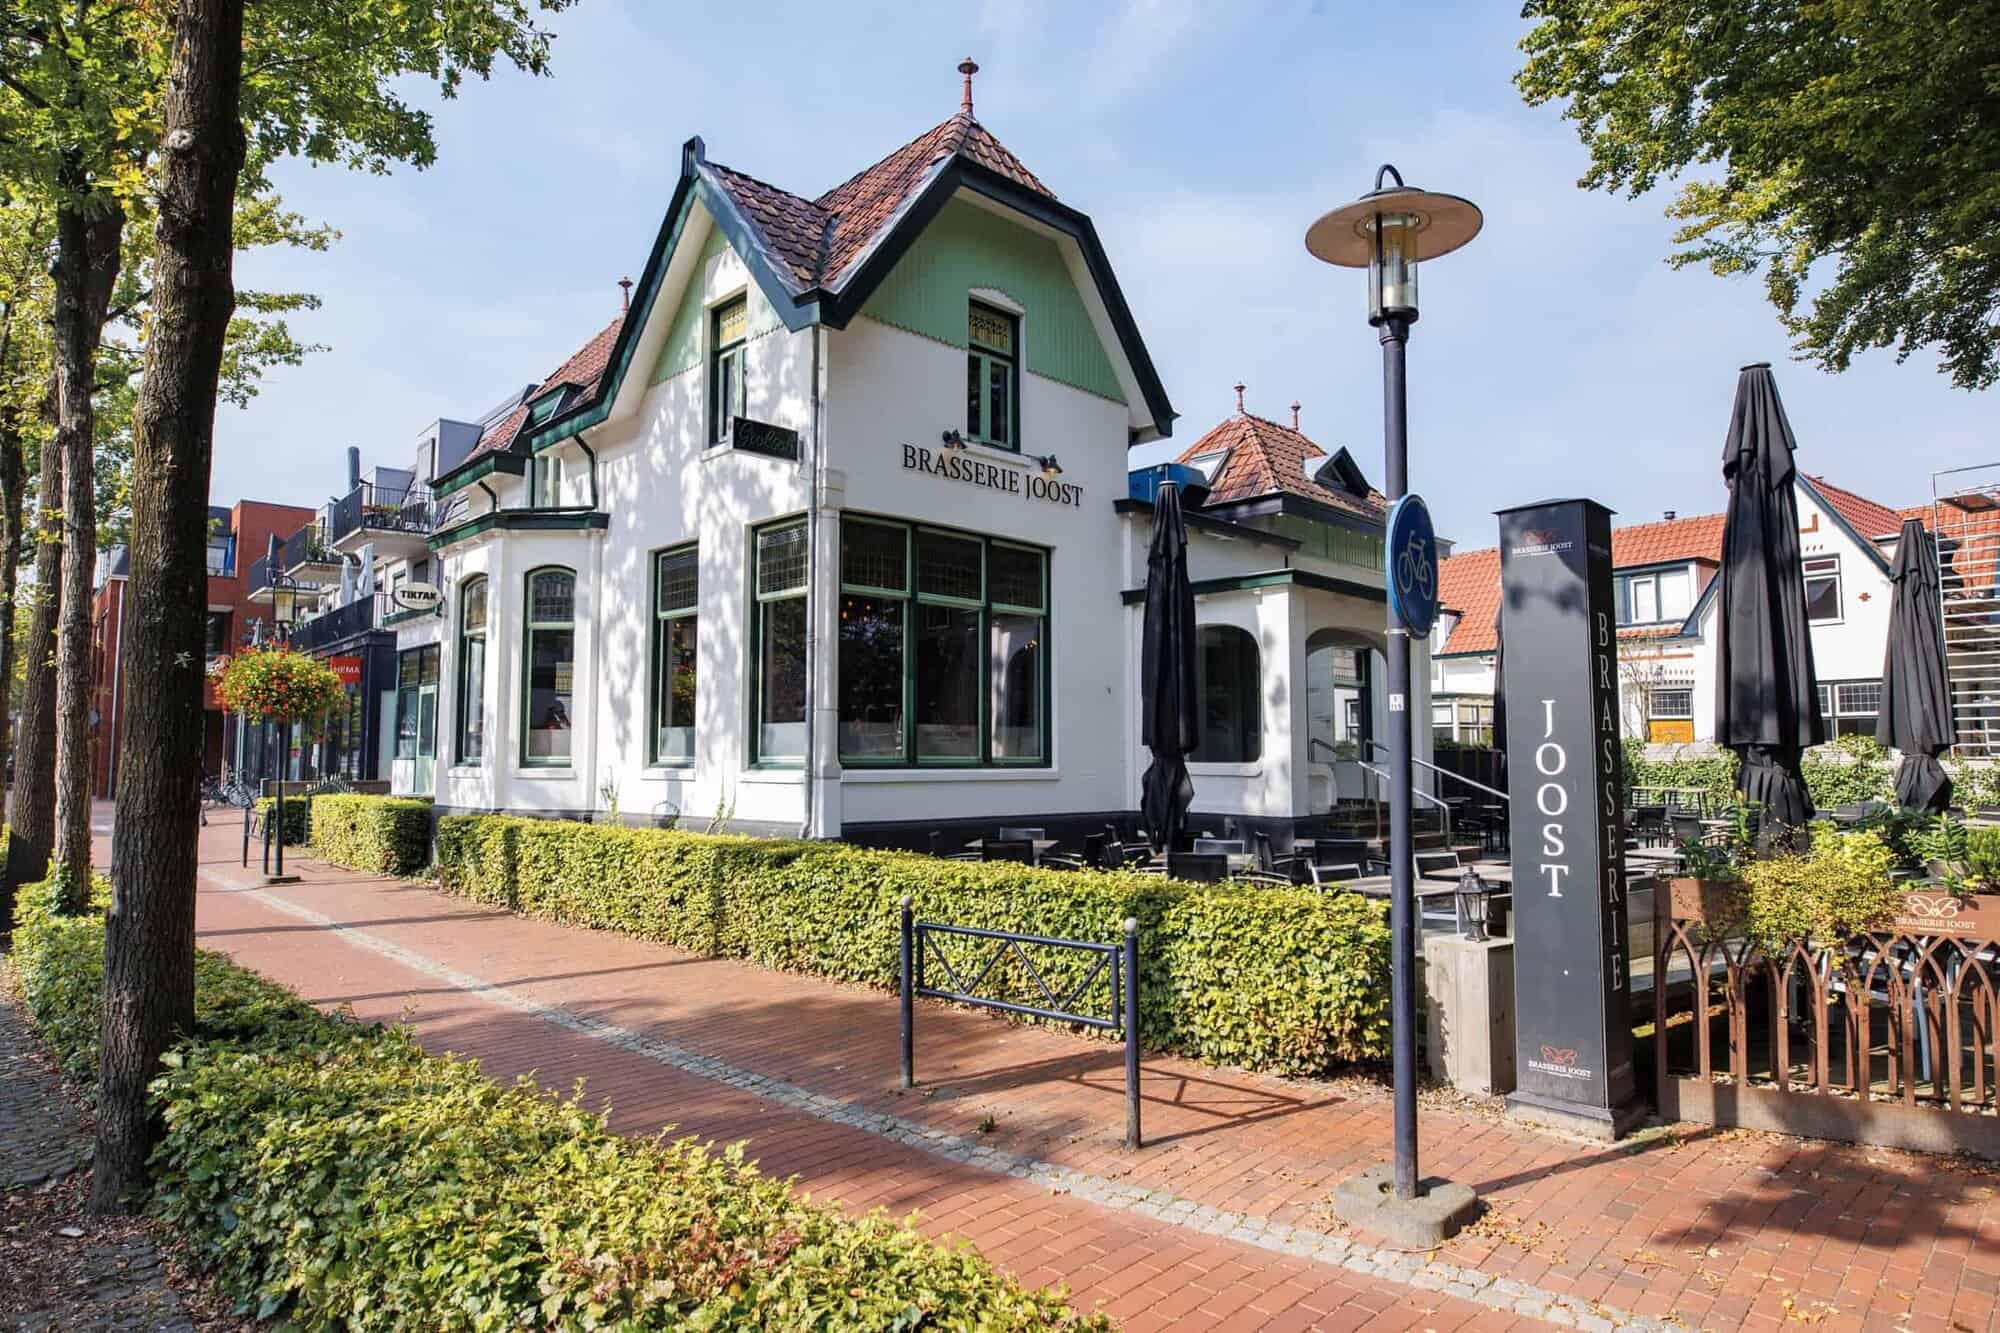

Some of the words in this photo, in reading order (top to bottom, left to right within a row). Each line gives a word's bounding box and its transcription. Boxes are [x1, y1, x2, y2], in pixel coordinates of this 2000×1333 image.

[903, 444, 1019, 493] BRASSERIE
[1026, 474, 1083, 507] JOOST
[1535, 699, 1569, 897] JOOST
[1597, 612, 1622, 991] BRASSERIE
[1946, 920, 1976, 929] JOOST
